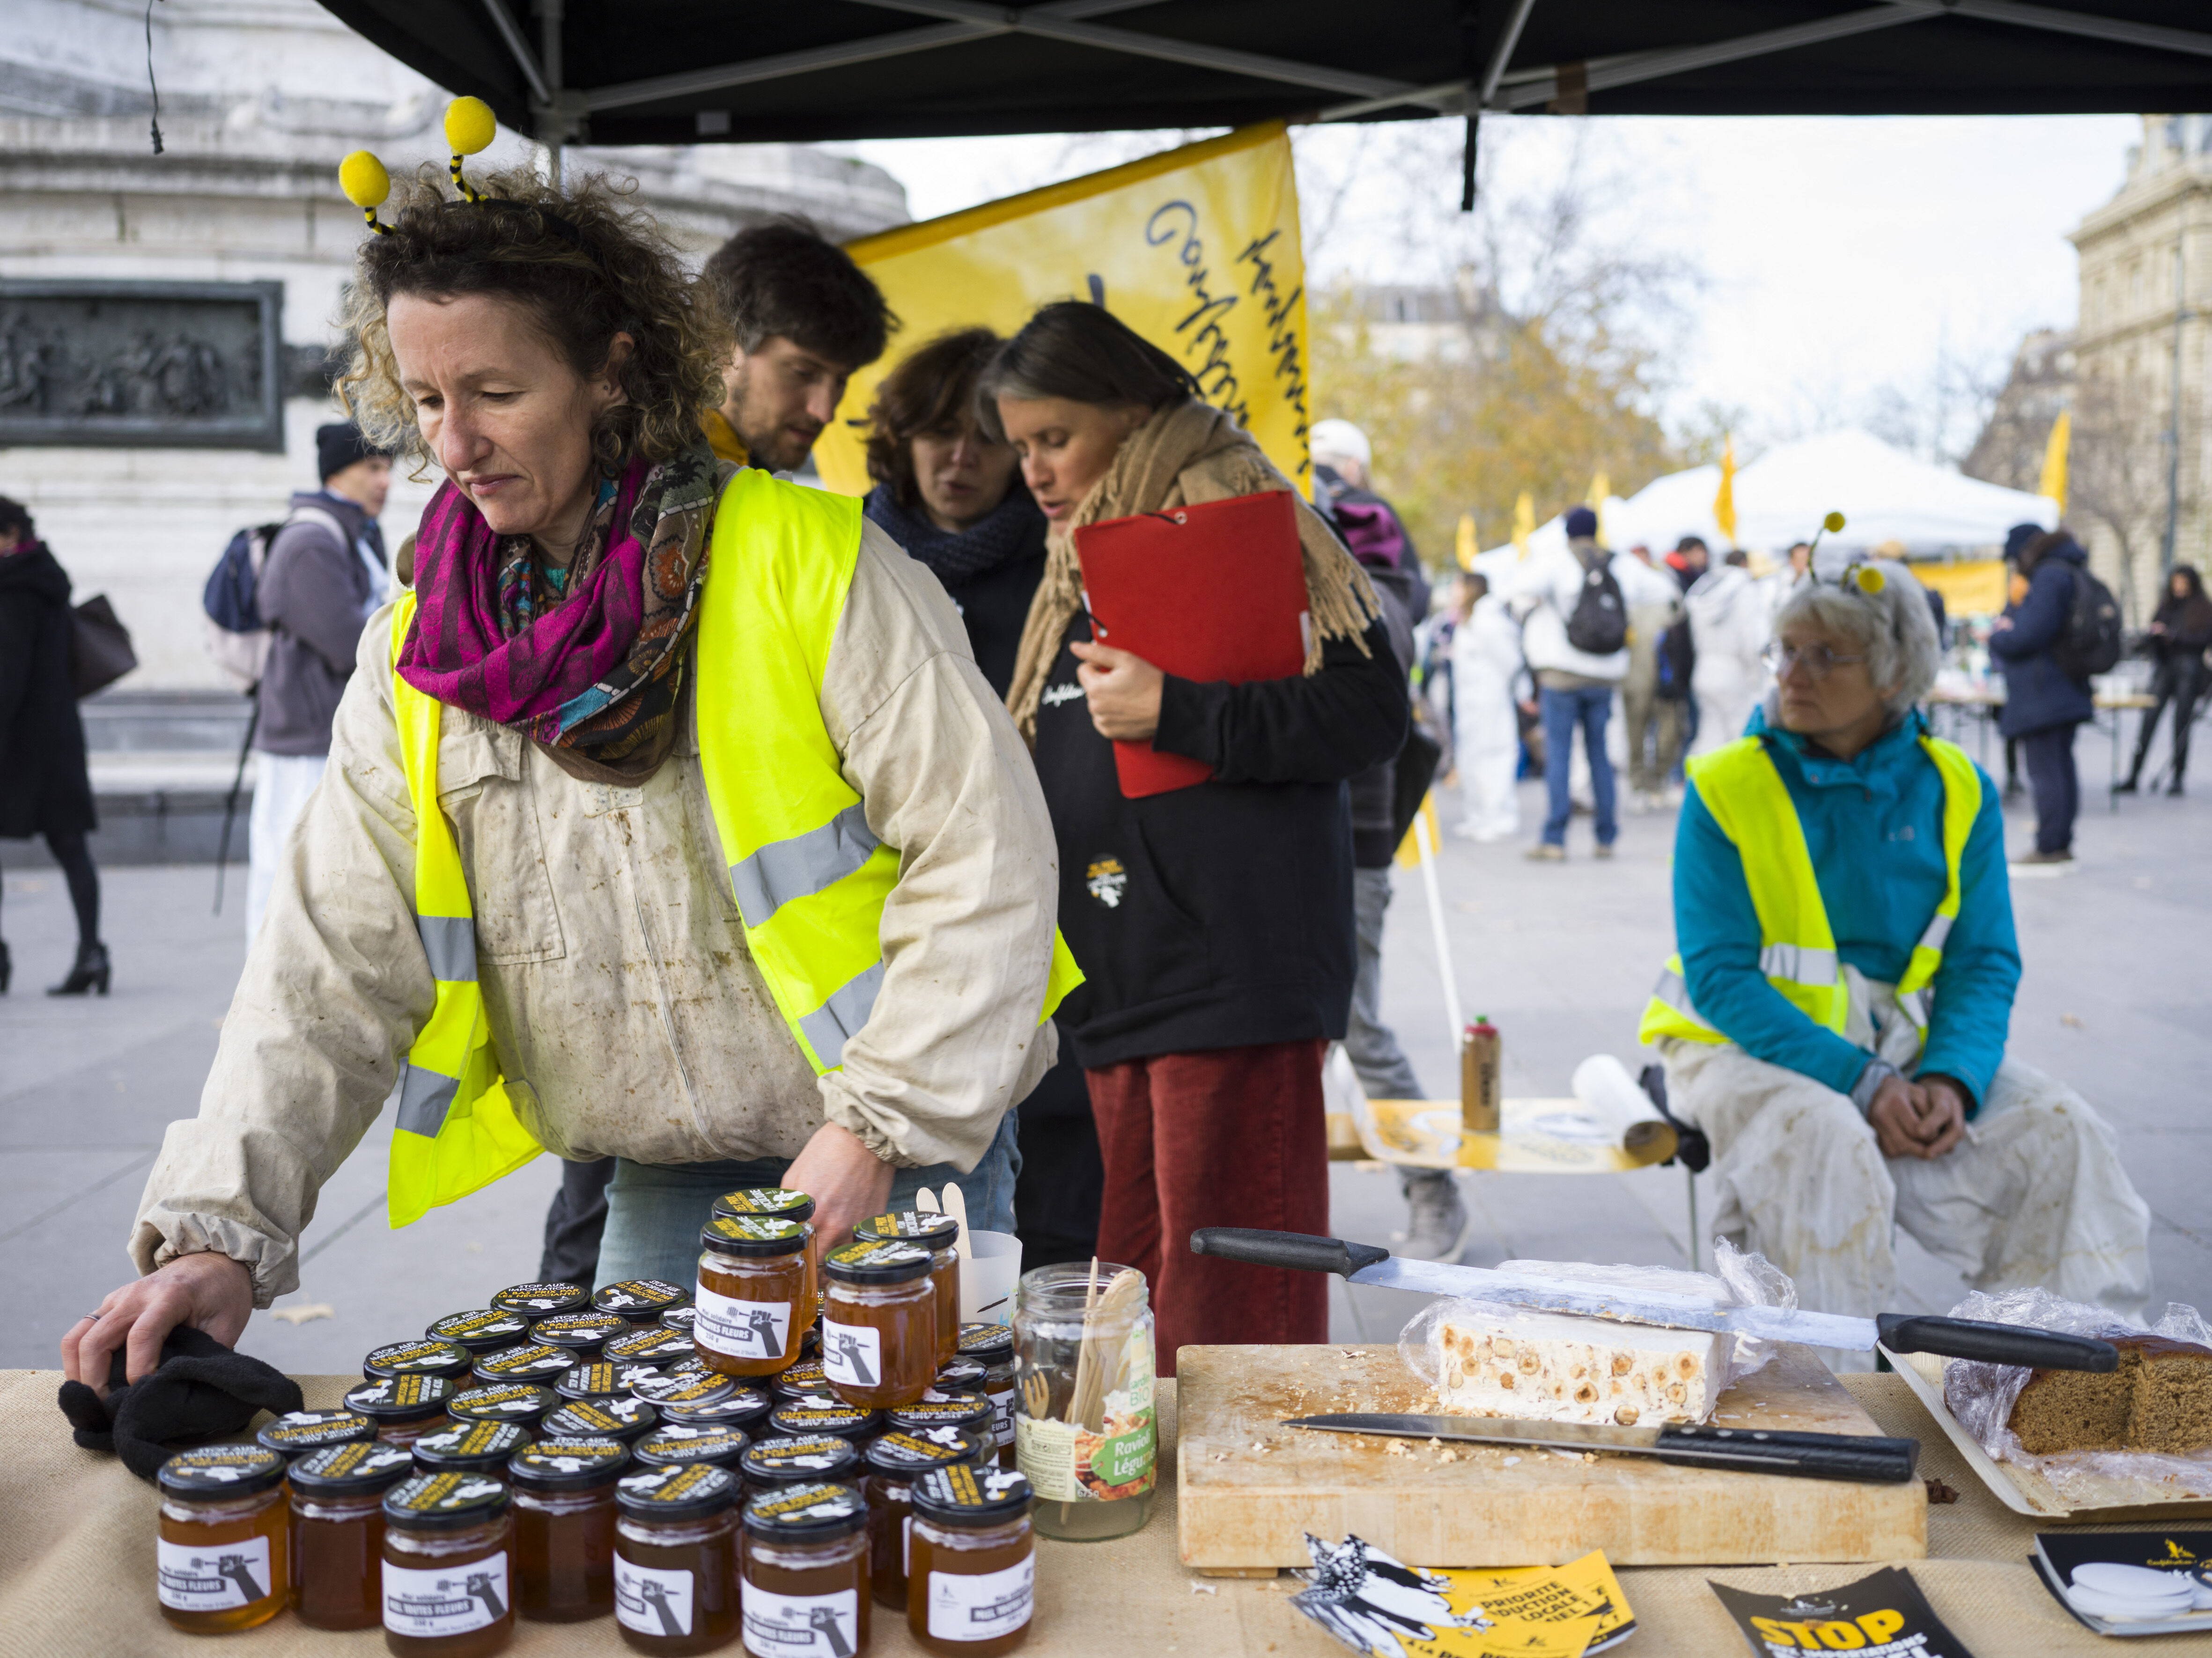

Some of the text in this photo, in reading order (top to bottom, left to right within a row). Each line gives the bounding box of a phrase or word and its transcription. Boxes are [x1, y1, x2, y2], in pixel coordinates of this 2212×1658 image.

[636, 1281, 678, 1296] IMPORTATIONS
[437, 1310, 494, 1330] IMPORTATIONS
[439, 1317, 458, 1326] STOP
[544, 1315, 612, 1324] IMPORTATIONS
[711, 1313, 732, 1324] solidaire
[449, 1323, 467, 1332] BAS
[702, 1318, 721, 1333] TOUTES
[722, 1327, 749, 1339] FLEURS
[609, 1337, 628, 1345] STOP
[610, 1329, 662, 1349] IMPORTATIONS
[369, 1341, 433, 1361] IMPORTATIONS
[373, 1348, 395, 1356] STOP
[483, 1353, 503, 1362] STOP
[784, 1366, 824, 1375] IMPORTA
[992, 1420, 1008, 1431] EURS
[1114, 1427, 1151, 1457] Ravioli
[1520, 1594, 1584, 1622] LOCALE
[1750, 1608, 1905, 1650] STOP
